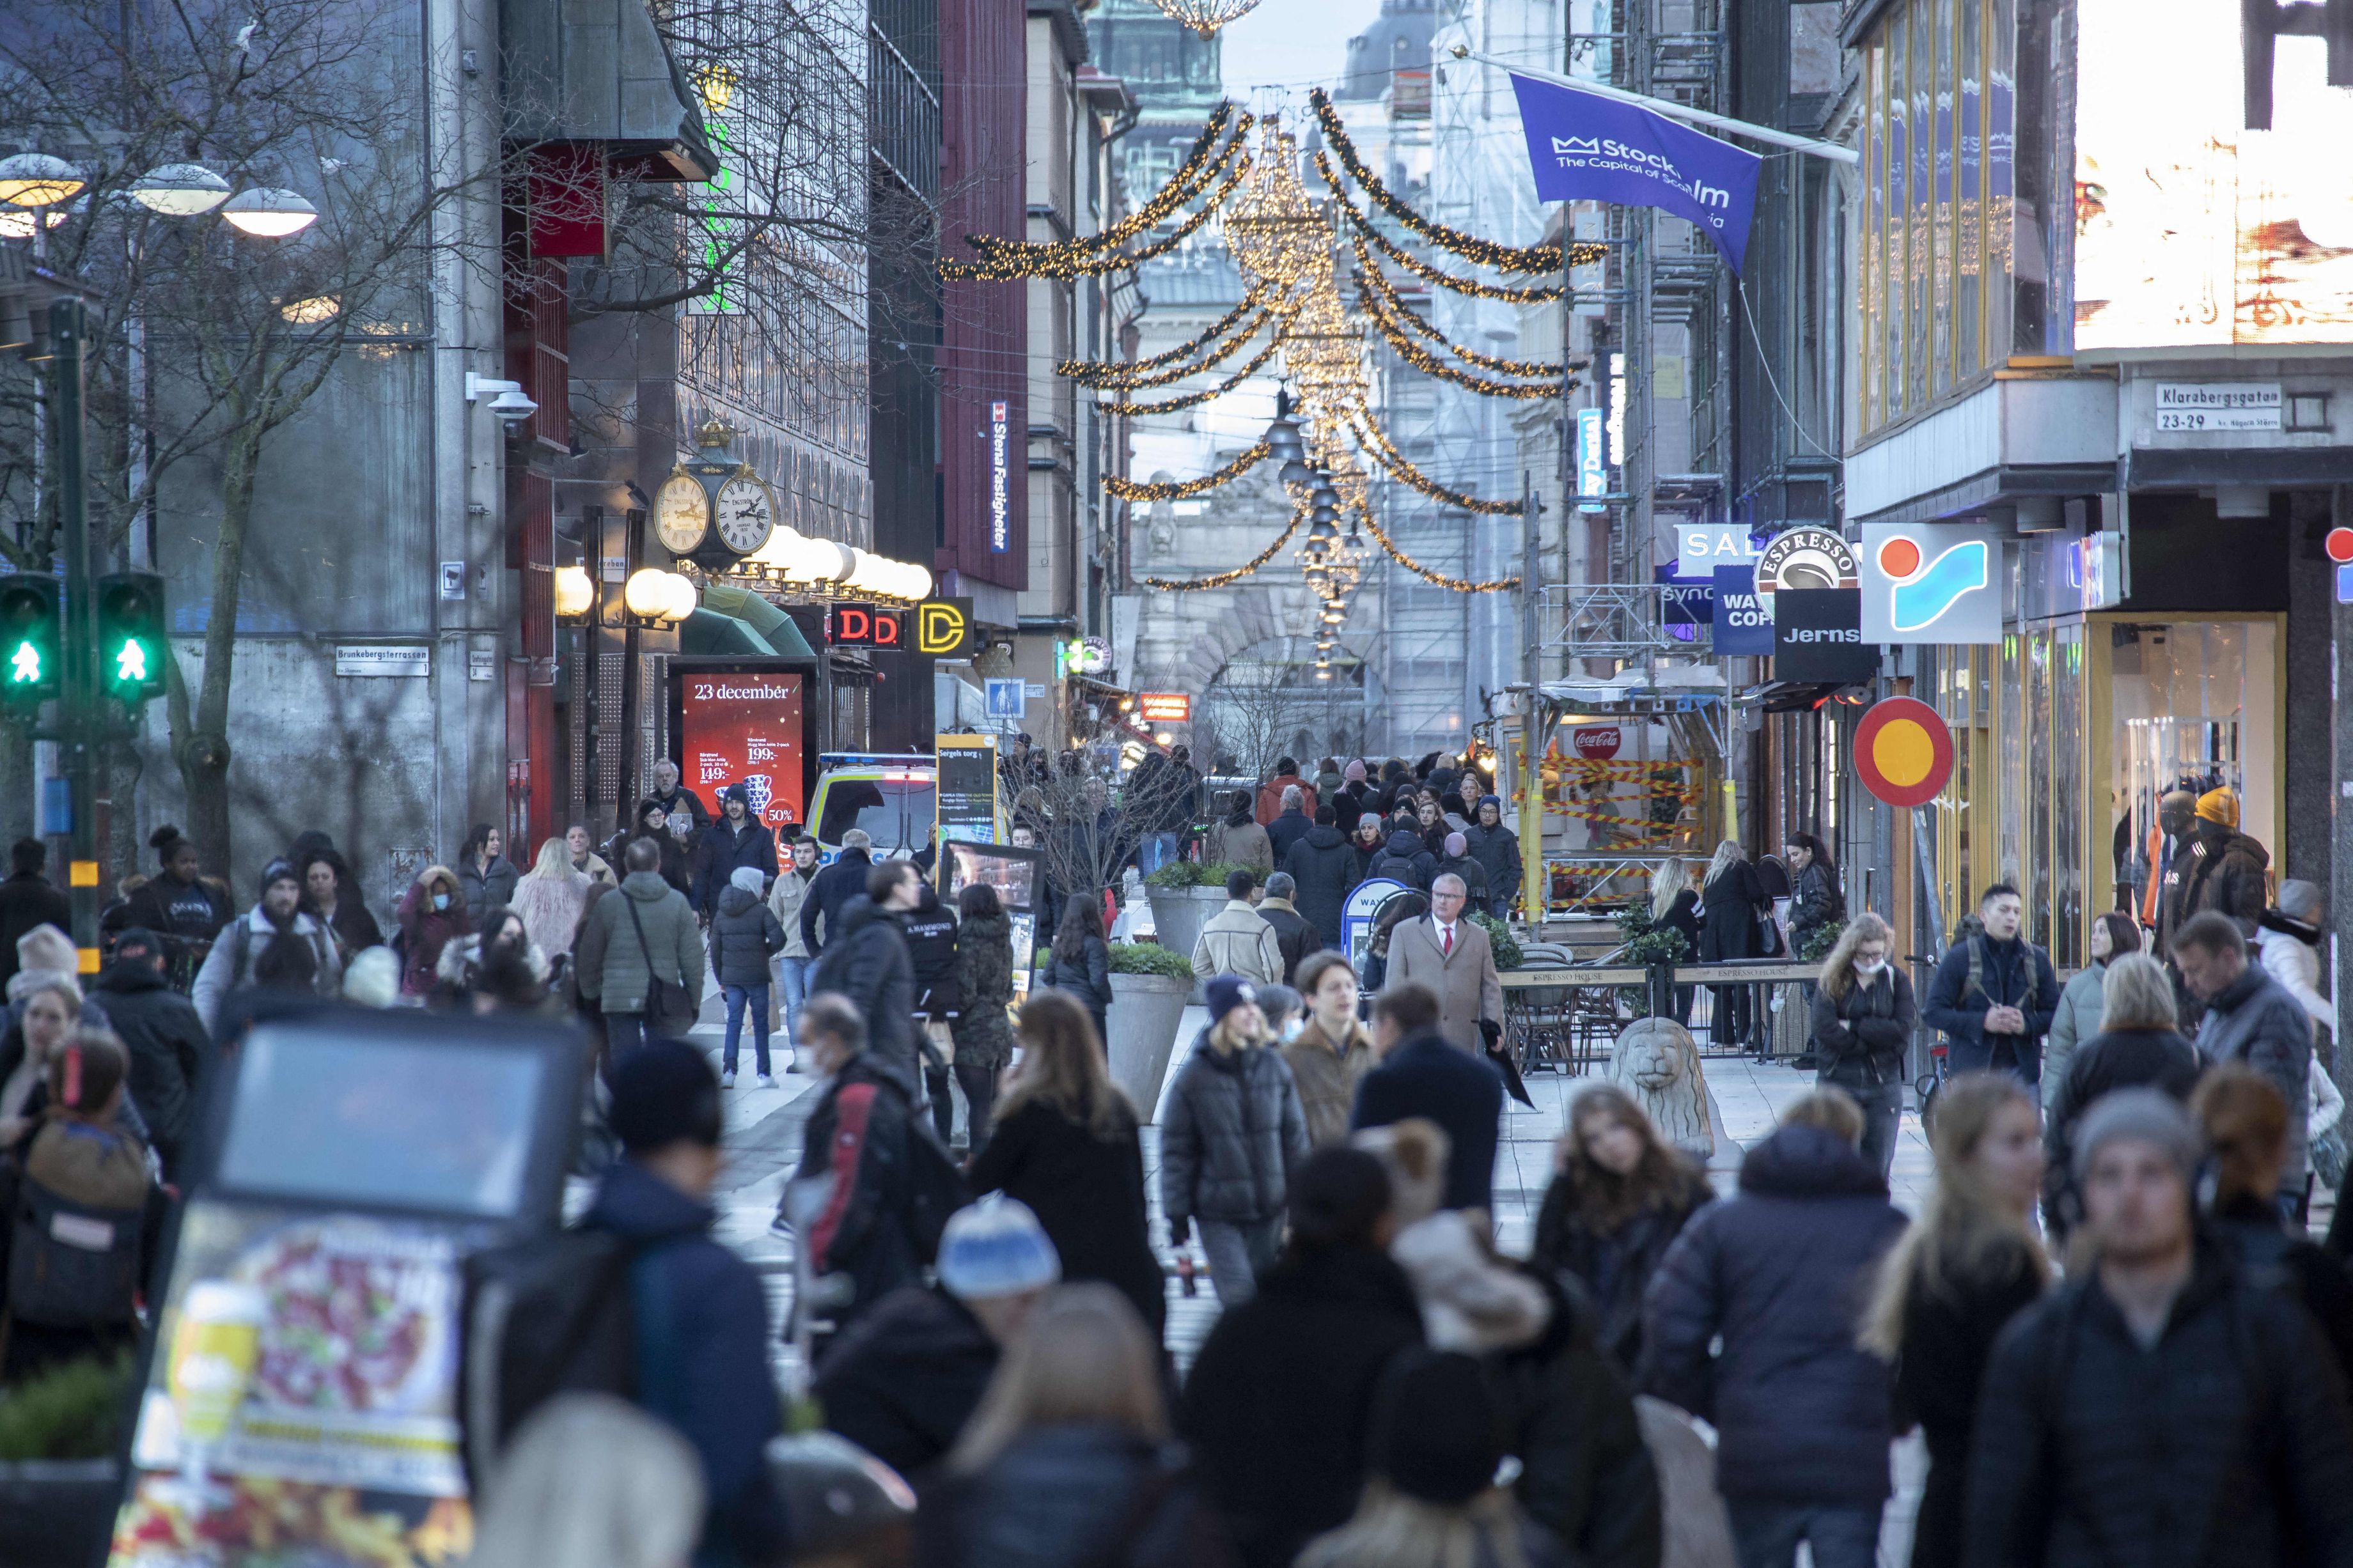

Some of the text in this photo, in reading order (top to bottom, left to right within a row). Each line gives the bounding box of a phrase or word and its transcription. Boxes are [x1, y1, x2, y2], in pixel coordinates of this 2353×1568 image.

[1556, 157, 1586, 167] The
[1588, 158, 1642, 175] Capital
[1645, 169, 1659, 179] of
[1602, 139, 1730, 208] Stocklm
[2163, 389, 2278, 406] Klarabergsgatan
[2162, 415, 2205, 428] 23-29
[994, 422, 1007, 466] Stena
[992, 467, 1007, 549] Fastigheter
[1687, 532, 1763, 557] SAL
[1762, 532, 1854, 575] ESPRESSO
[338, 649, 426, 660] Brunkebergsterrassen
[694, 684, 789, 700] 23 december
[747, 747, 778, 760] 199:-
[939, 749, 978, 759] Sergels torg
[700, 767, 730, 780] 149:-
[769, 809, 792, 821] 50%
[1575, 972, 1603, 981] HOUSE
